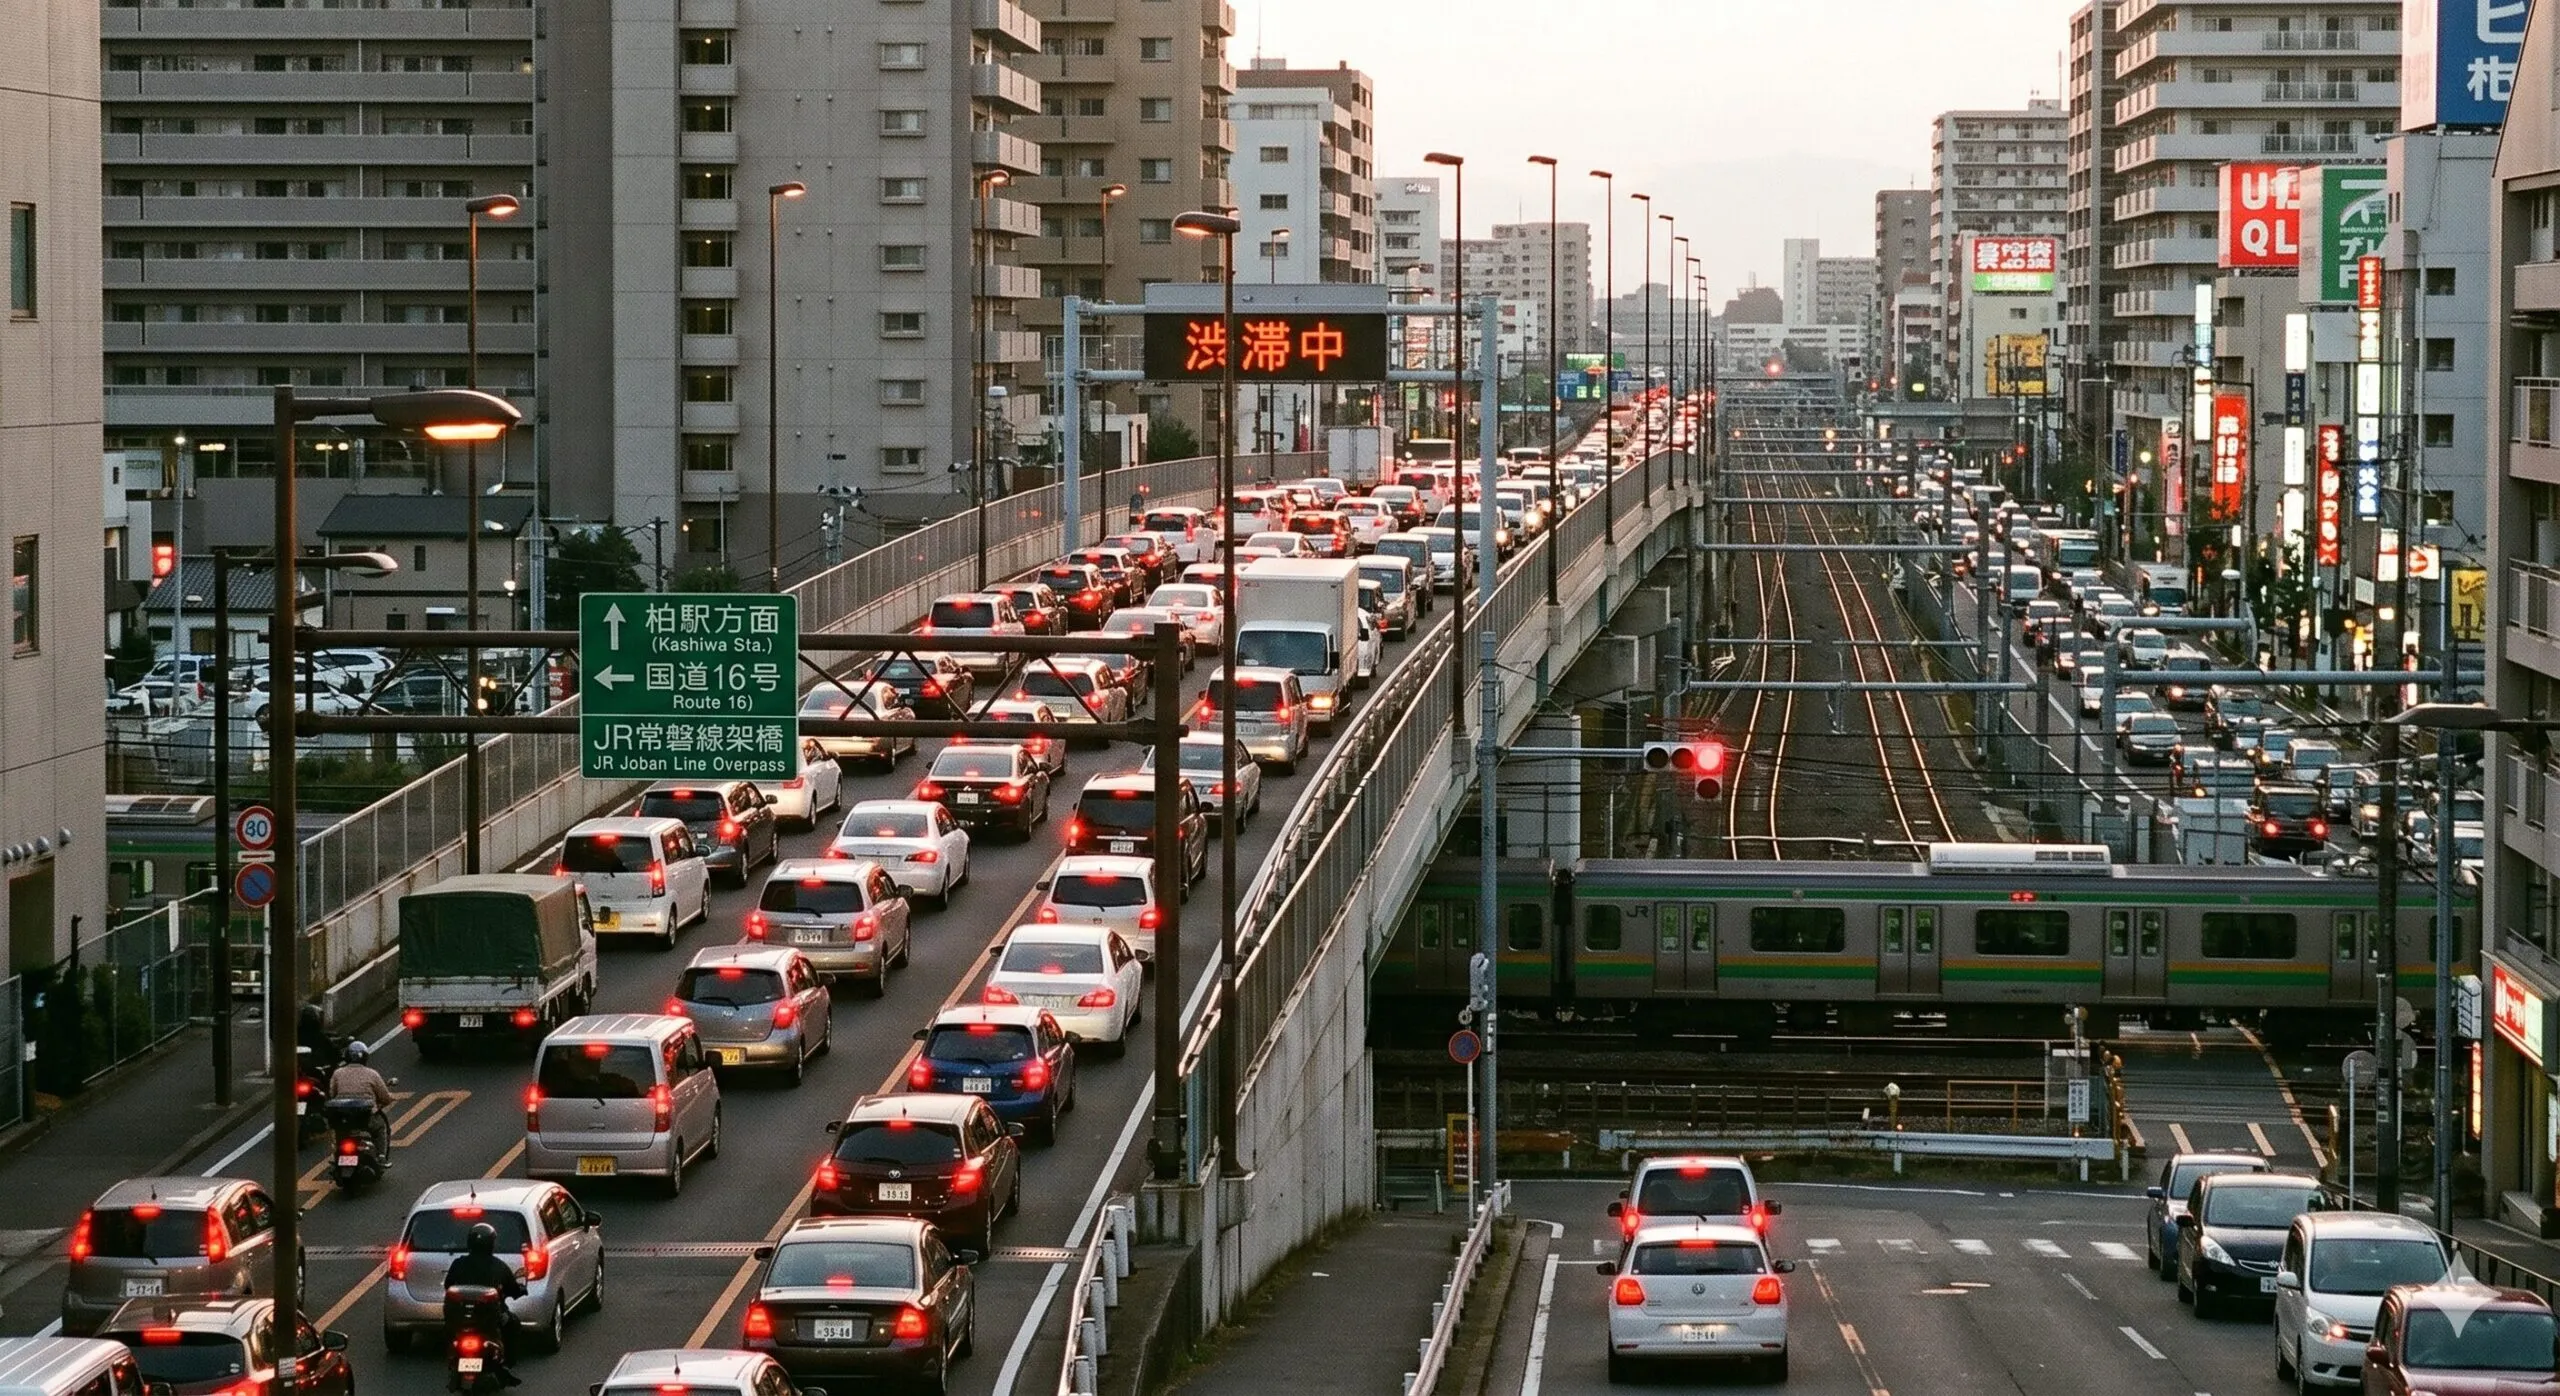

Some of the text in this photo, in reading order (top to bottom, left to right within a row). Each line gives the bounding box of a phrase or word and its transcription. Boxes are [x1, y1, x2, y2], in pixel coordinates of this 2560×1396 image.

[1185, 320, 1344, 372] 渋滞中
[645, 602, 780, 635] 柏駅方面
[651, 637, 773, 654] (Kashiwa Sta.)
[646, 662, 781, 692] 国道16号
[673, 695, 753, 711] Route 16)
[593, 722, 784, 753] JR常磐線架橋
[593, 755, 786, 774] JR Joban Line Overpass
[1626, 904, 1649, 918] JR
